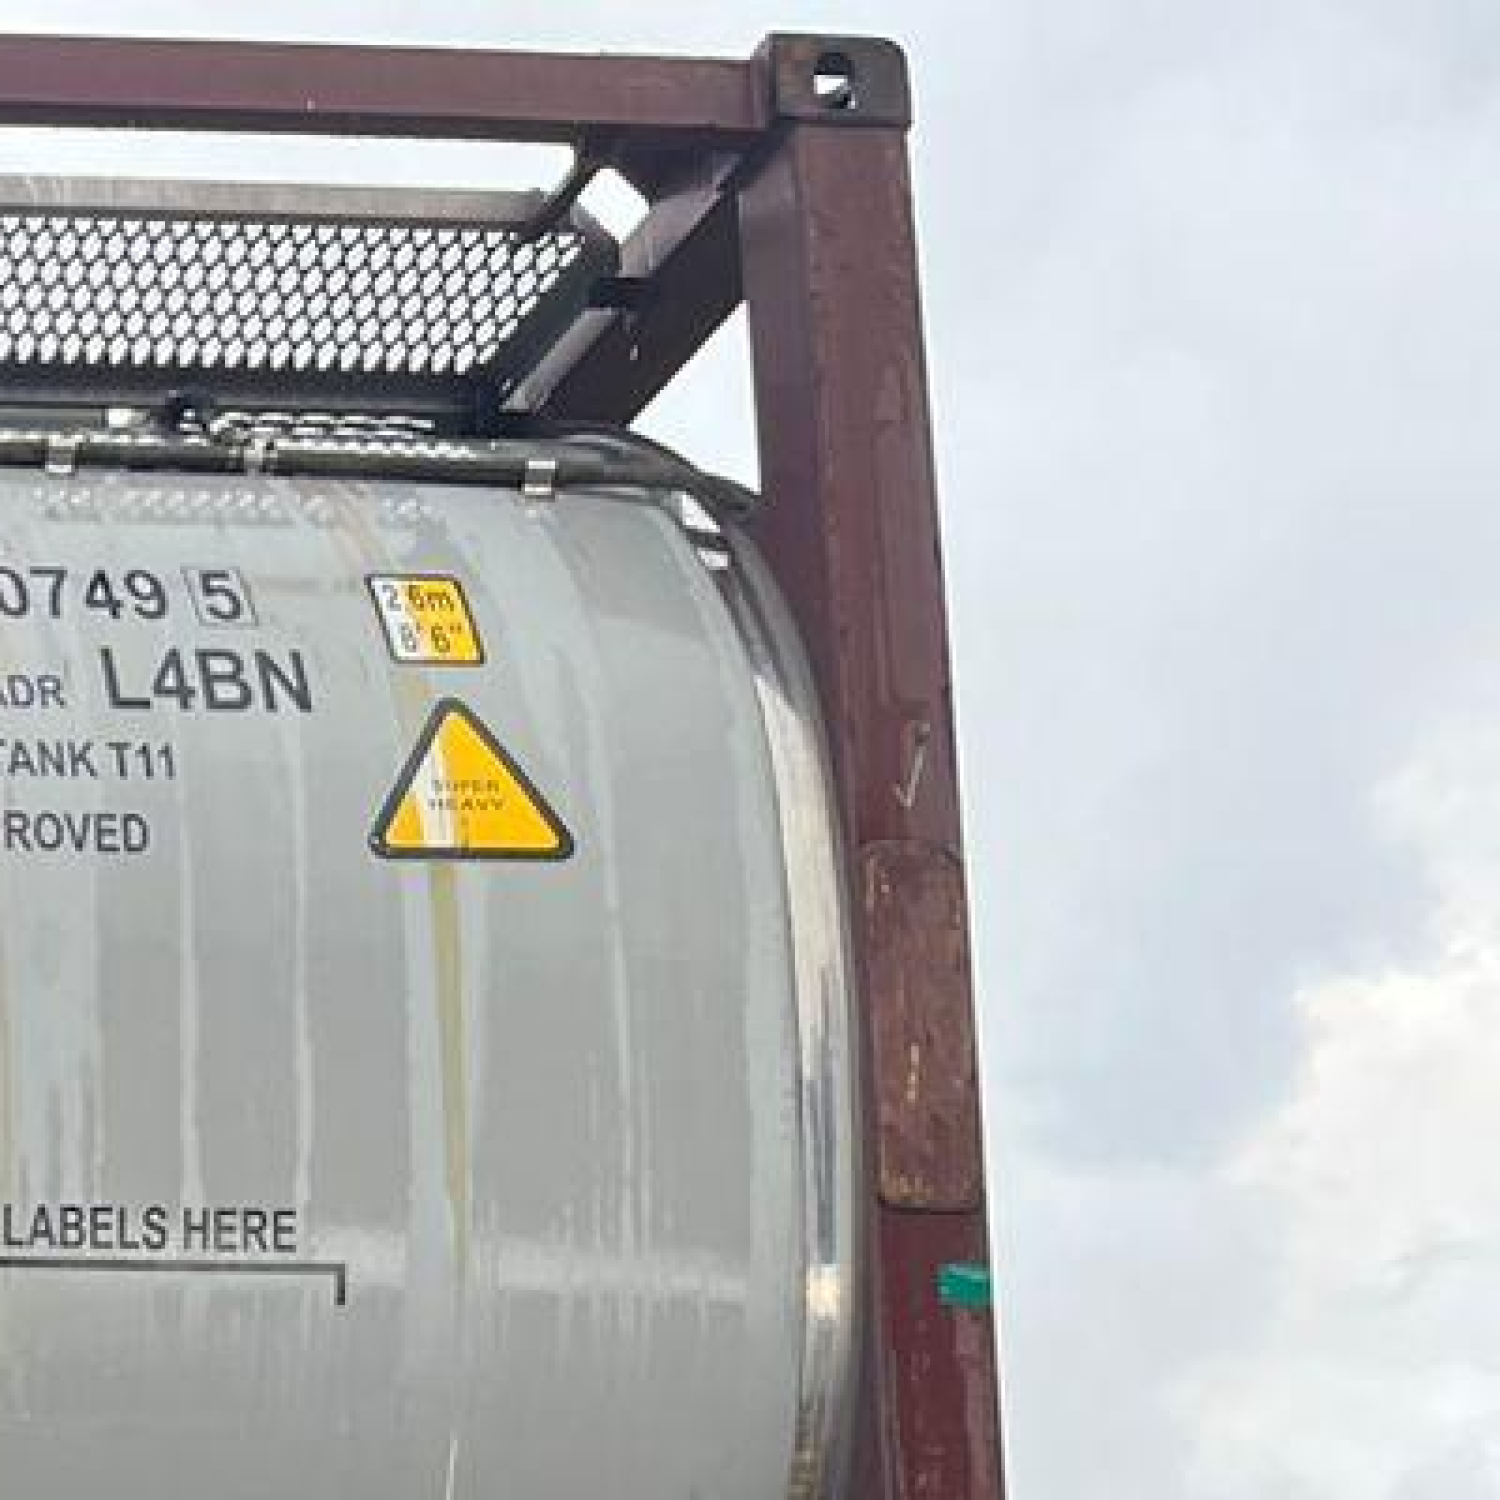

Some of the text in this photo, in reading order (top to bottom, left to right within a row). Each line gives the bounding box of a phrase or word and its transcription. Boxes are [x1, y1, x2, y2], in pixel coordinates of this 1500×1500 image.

[200, 569, 242, 620] 5
[100, 646, 312, 712] L4BN
[108, 741, 176, 780] T11
[3, 1204, 168, 1250] LABELS
[183, 1207, 297, 1254] HERE
